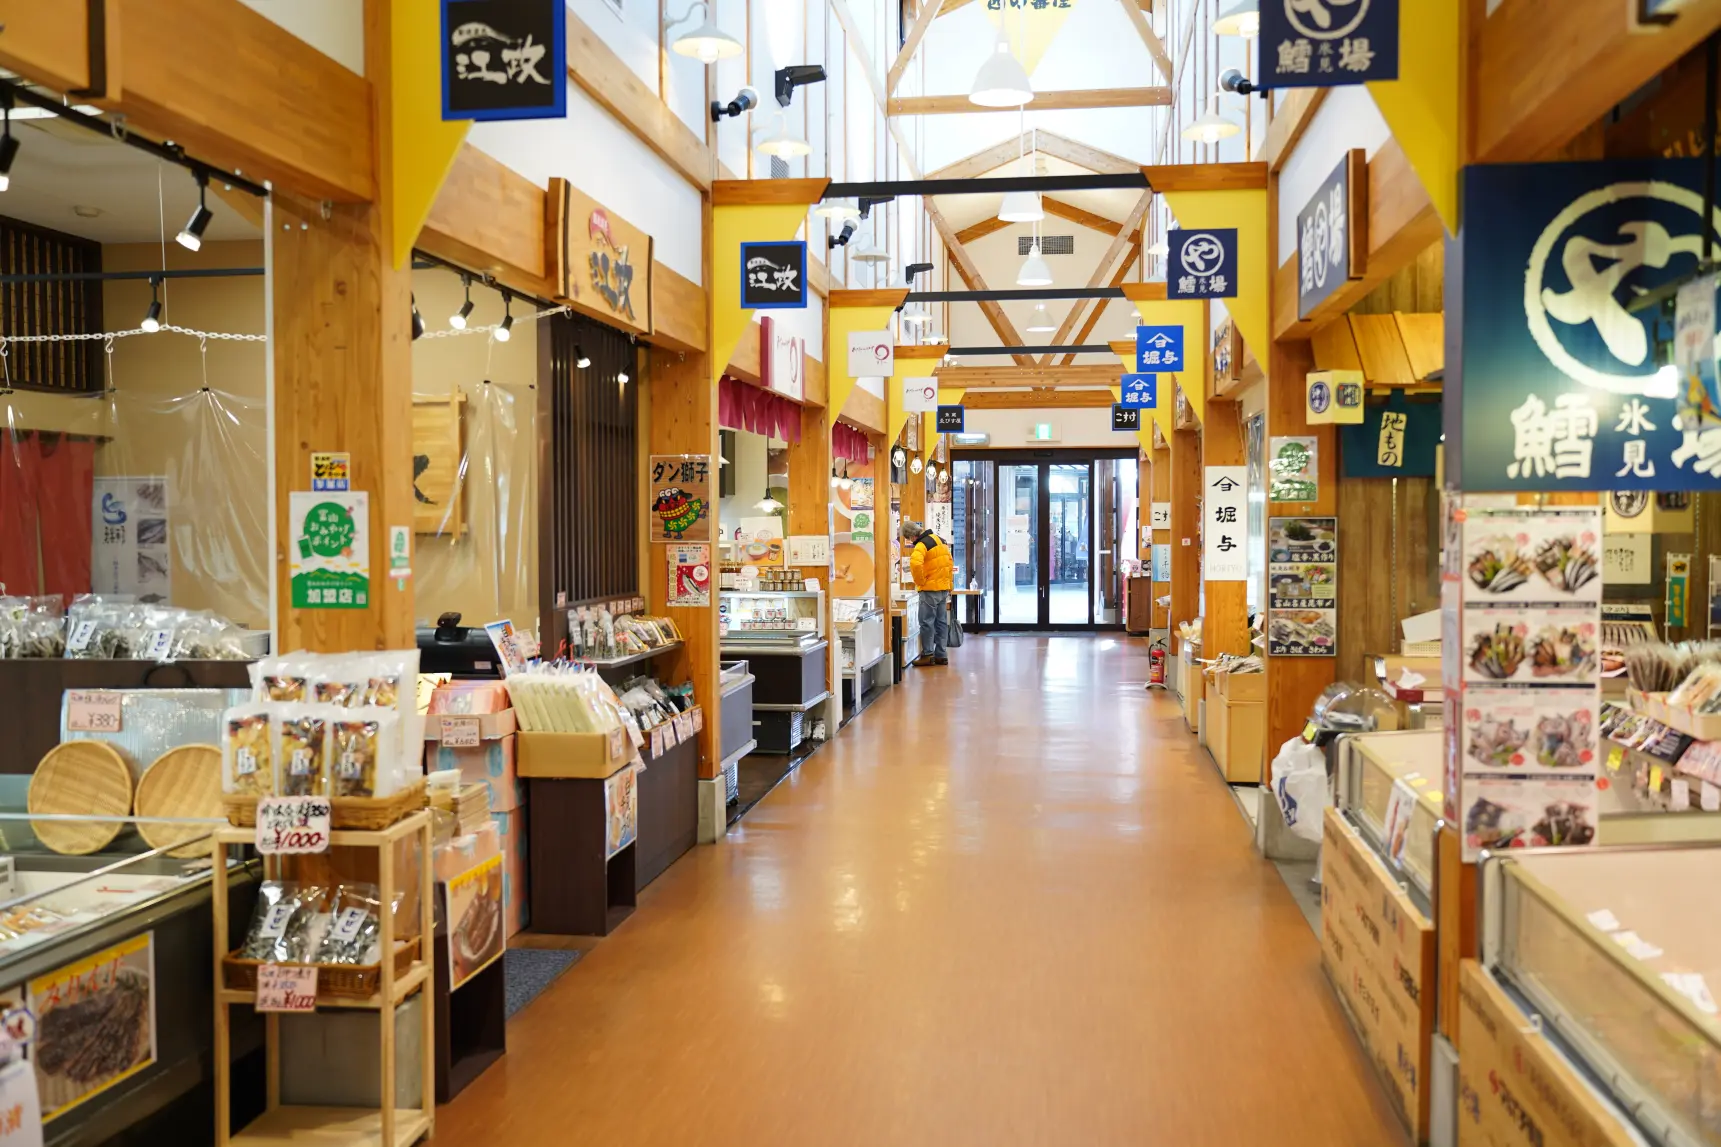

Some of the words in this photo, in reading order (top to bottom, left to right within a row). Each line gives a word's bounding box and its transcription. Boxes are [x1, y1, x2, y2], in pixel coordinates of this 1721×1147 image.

[1143, 350, 1178, 364] 堀与
[1125, 392, 1152, 403] 堀与
[1116, 412, 1136, 422] こすけ
[1380, 415, 1403, 466] 地もの
[1614, 398, 1656, 478] 氷見
[653, 461, 708, 482] ダン獅子
[1215, 506, 1237, 552] 堀与
[307, 588, 353, 604] 加盟店
